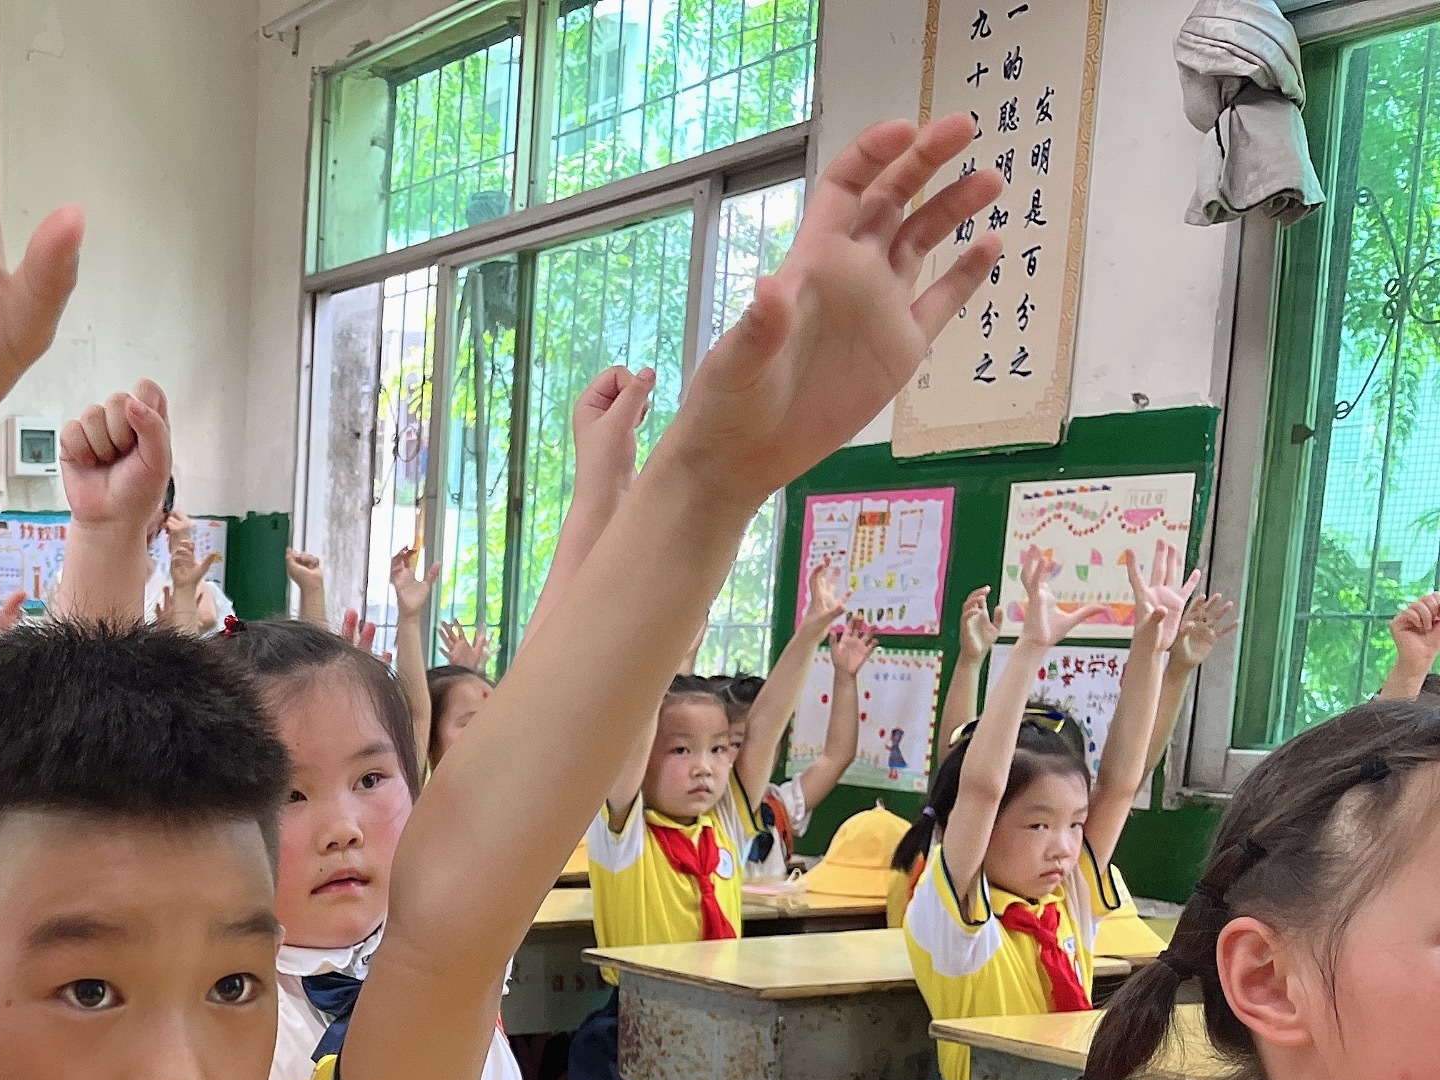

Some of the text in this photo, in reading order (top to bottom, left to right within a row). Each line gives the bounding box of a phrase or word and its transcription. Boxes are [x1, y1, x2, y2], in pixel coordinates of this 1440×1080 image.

[1009, 87, 1055, 378] 发明是百分之
